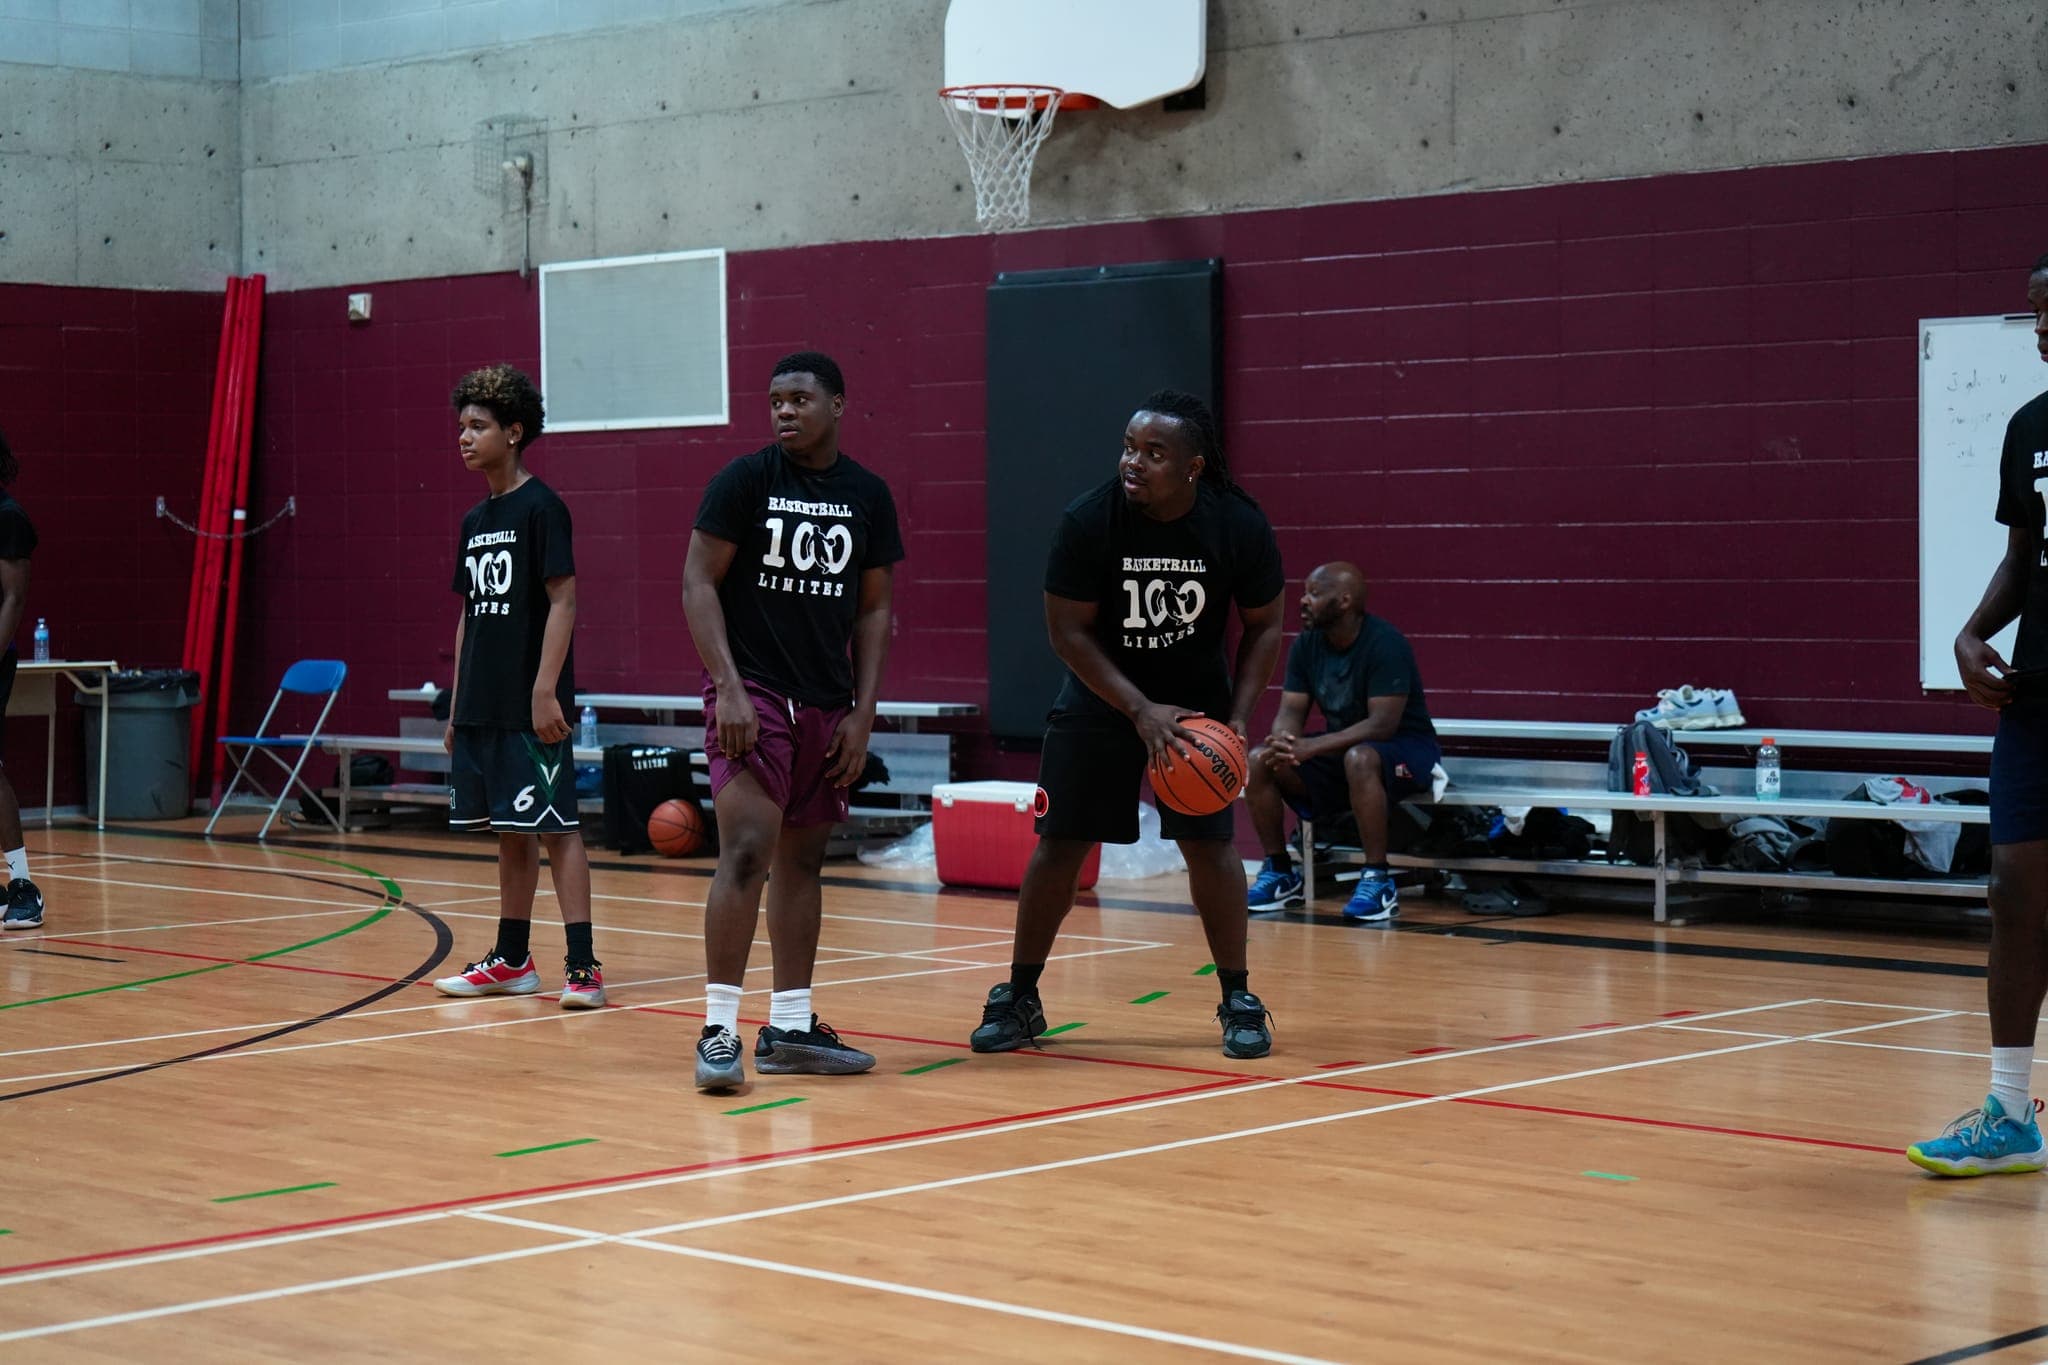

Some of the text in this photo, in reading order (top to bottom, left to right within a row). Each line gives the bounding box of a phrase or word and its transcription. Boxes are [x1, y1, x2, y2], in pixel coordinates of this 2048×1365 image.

[768, 496, 852, 517] BASKETBALL
[763, 518, 853, 574] 100
[1122, 557, 1206, 572] BASKETBALL
[758, 572, 844, 597] LIMITES
[474, 601, 510, 616] ITES
[1123, 579, 1206, 628] 100
[1123, 622, 1195, 649] LIMITES
[513, 785, 535, 812] 6
